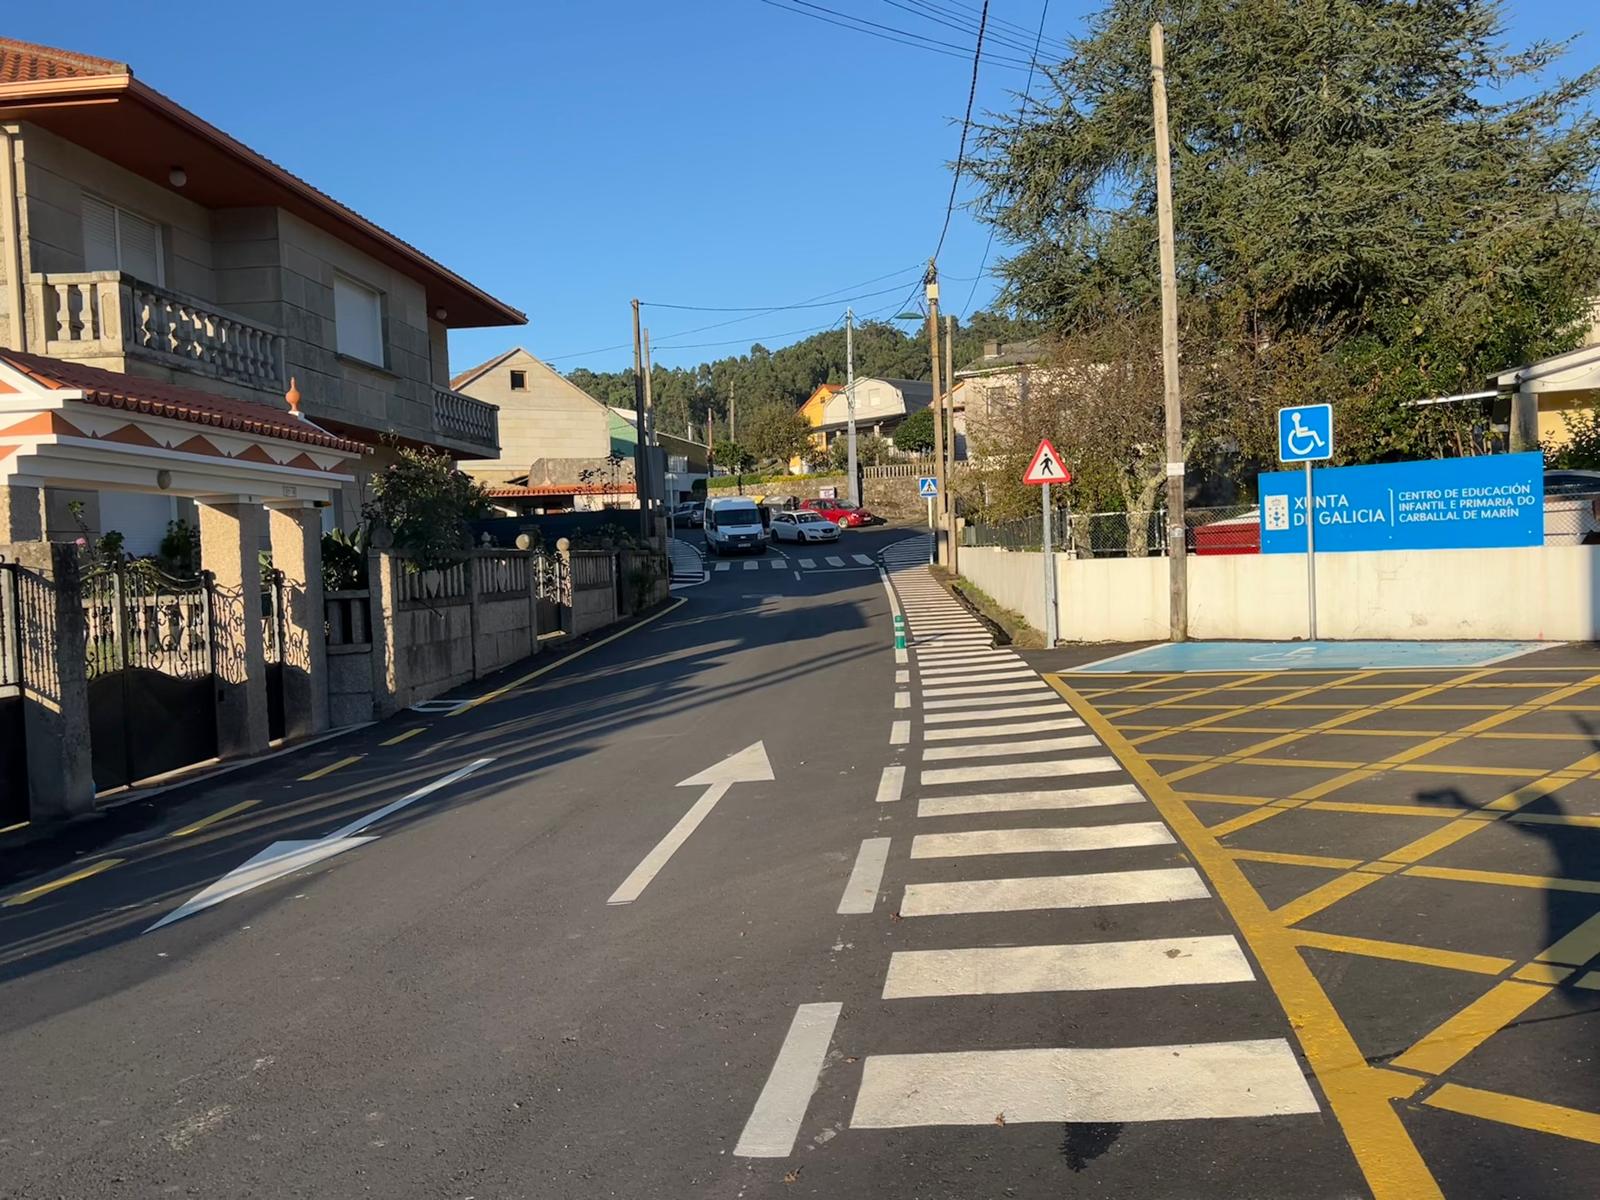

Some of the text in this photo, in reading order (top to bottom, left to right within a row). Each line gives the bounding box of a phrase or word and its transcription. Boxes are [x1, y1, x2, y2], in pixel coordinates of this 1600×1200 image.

[1398, 482, 1530, 501] CENTRO DE EDUCACIÓN
[1399, 495, 1535, 512] INFANTIL E PRIMARIA DO
[1294, 509, 1386, 526] D GALICIA
[1399, 506, 1519, 523] CARBALLAL DE MARÍN
